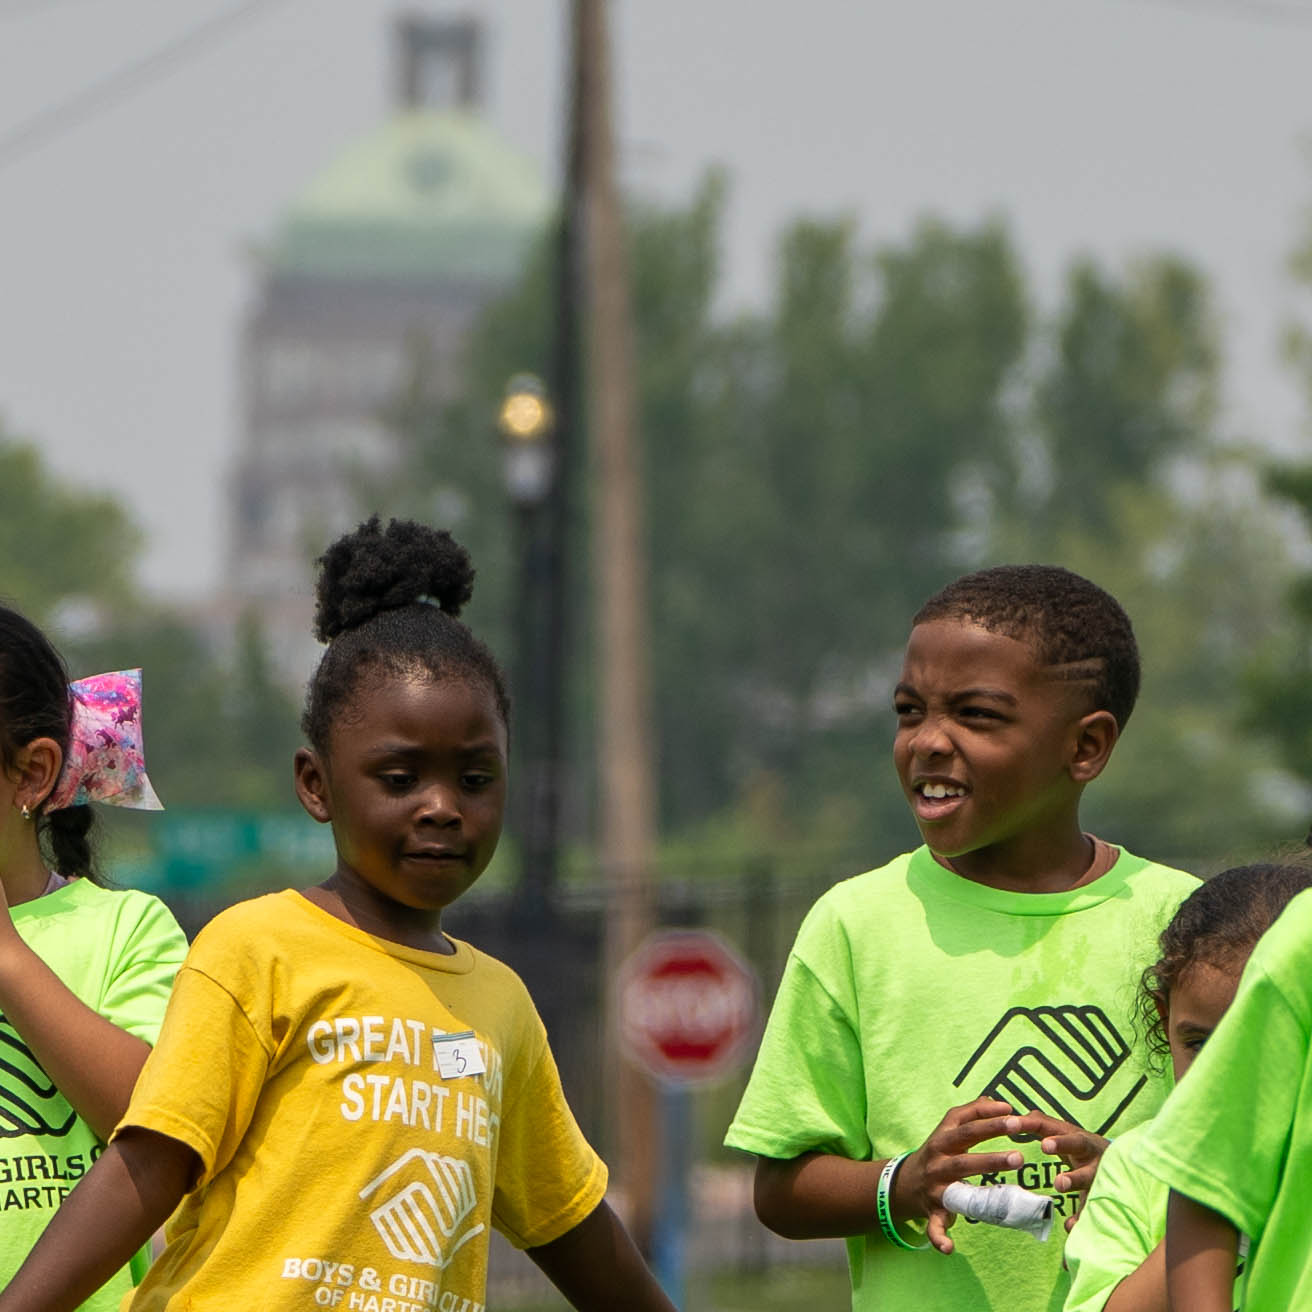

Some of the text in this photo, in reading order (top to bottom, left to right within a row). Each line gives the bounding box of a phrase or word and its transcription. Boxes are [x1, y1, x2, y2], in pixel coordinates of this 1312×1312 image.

[307, 1016, 426, 1065] GREAT
[452, 1048, 468, 1074] 3
[340, 1073, 450, 1133] START
[282, 1258, 355, 1287] BOYS
[359, 1267, 382, 1292] &
[315, 1287, 345, 1306] OF
